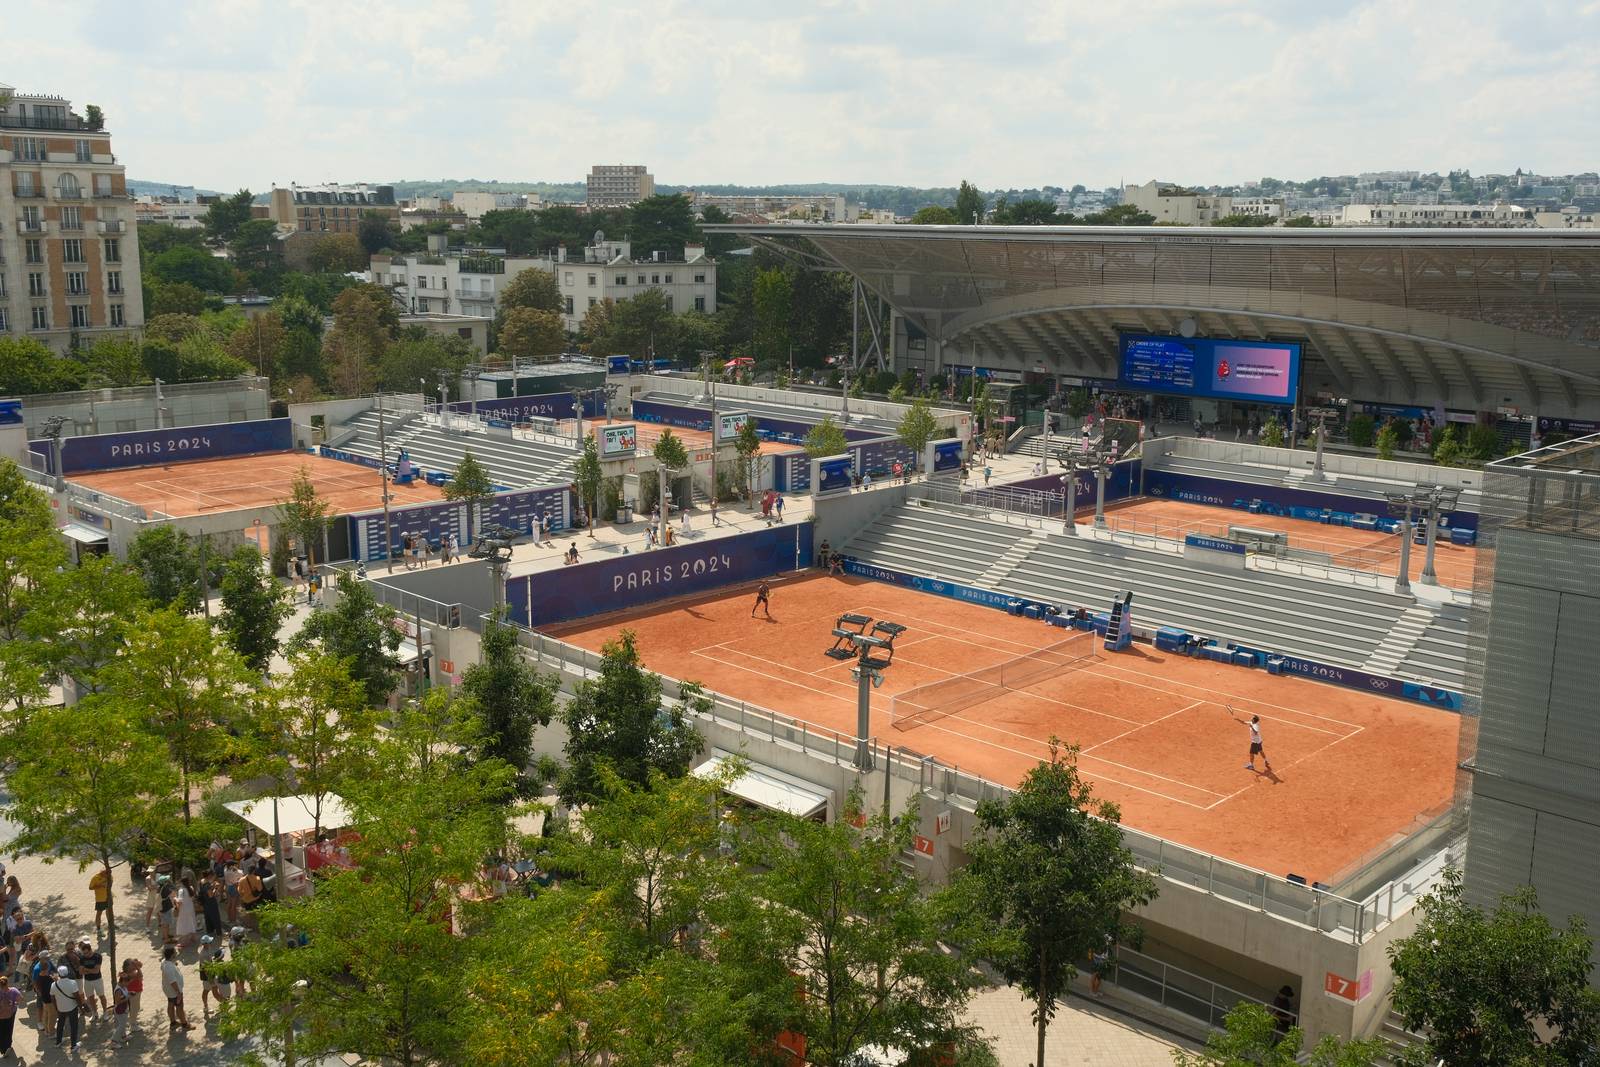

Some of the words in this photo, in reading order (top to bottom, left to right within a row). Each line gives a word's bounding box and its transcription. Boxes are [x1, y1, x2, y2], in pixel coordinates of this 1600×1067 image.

[523, 404, 553, 415] 2024
[167, 437, 211, 452] 2024
[1202, 496, 1223, 504] 2024
[681, 554, 730, 578] 2024
[875, 568, 895, 581] 2024
[1283, 659, 1309, 672] ARIS
[1312, 666, 1342, 680] 2024
[922, 839, 929, 852] 7
[1338, 979, 1349, 994] 7
